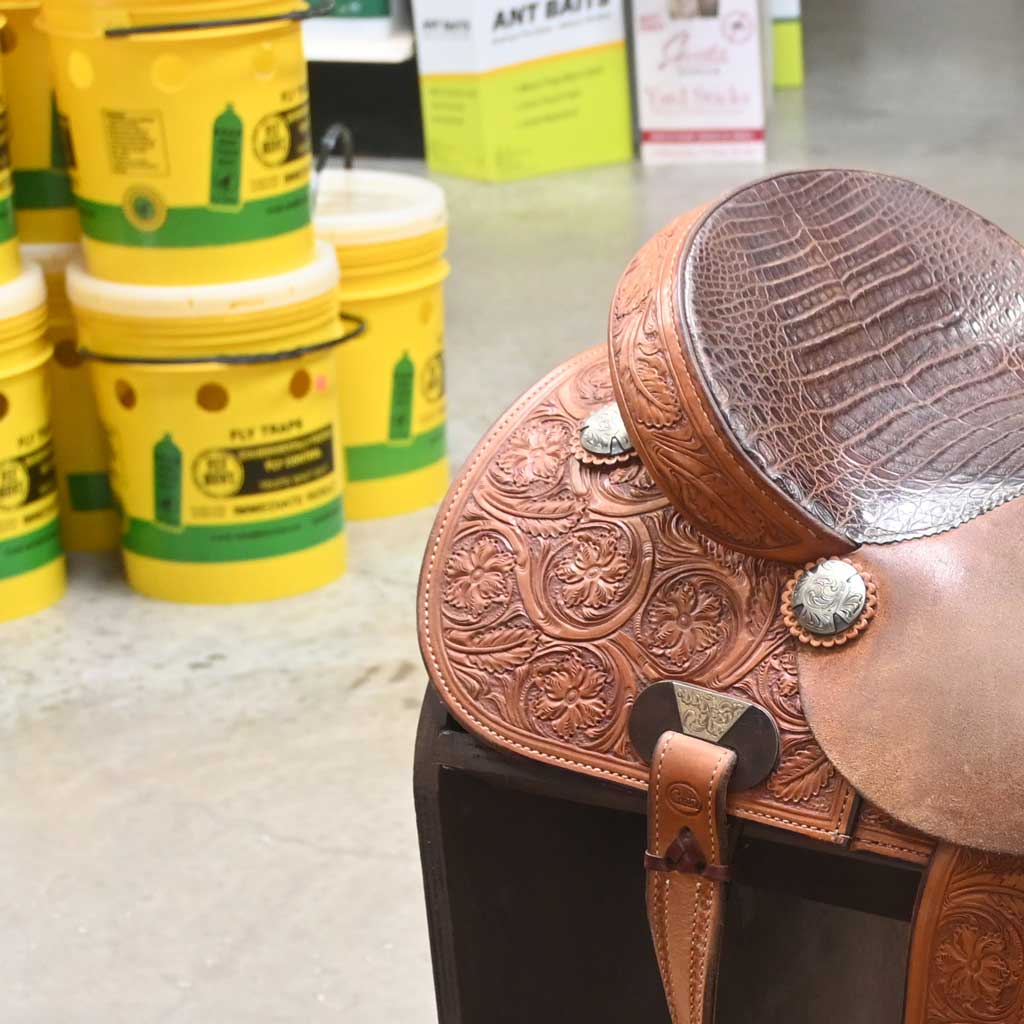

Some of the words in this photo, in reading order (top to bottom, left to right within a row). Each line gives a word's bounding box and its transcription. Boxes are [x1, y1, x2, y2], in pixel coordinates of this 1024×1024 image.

[493, 4, 539, 31] ANT
[229, 428, 255, 440] FLY
[261, 417, 303, 436] TRAPS
